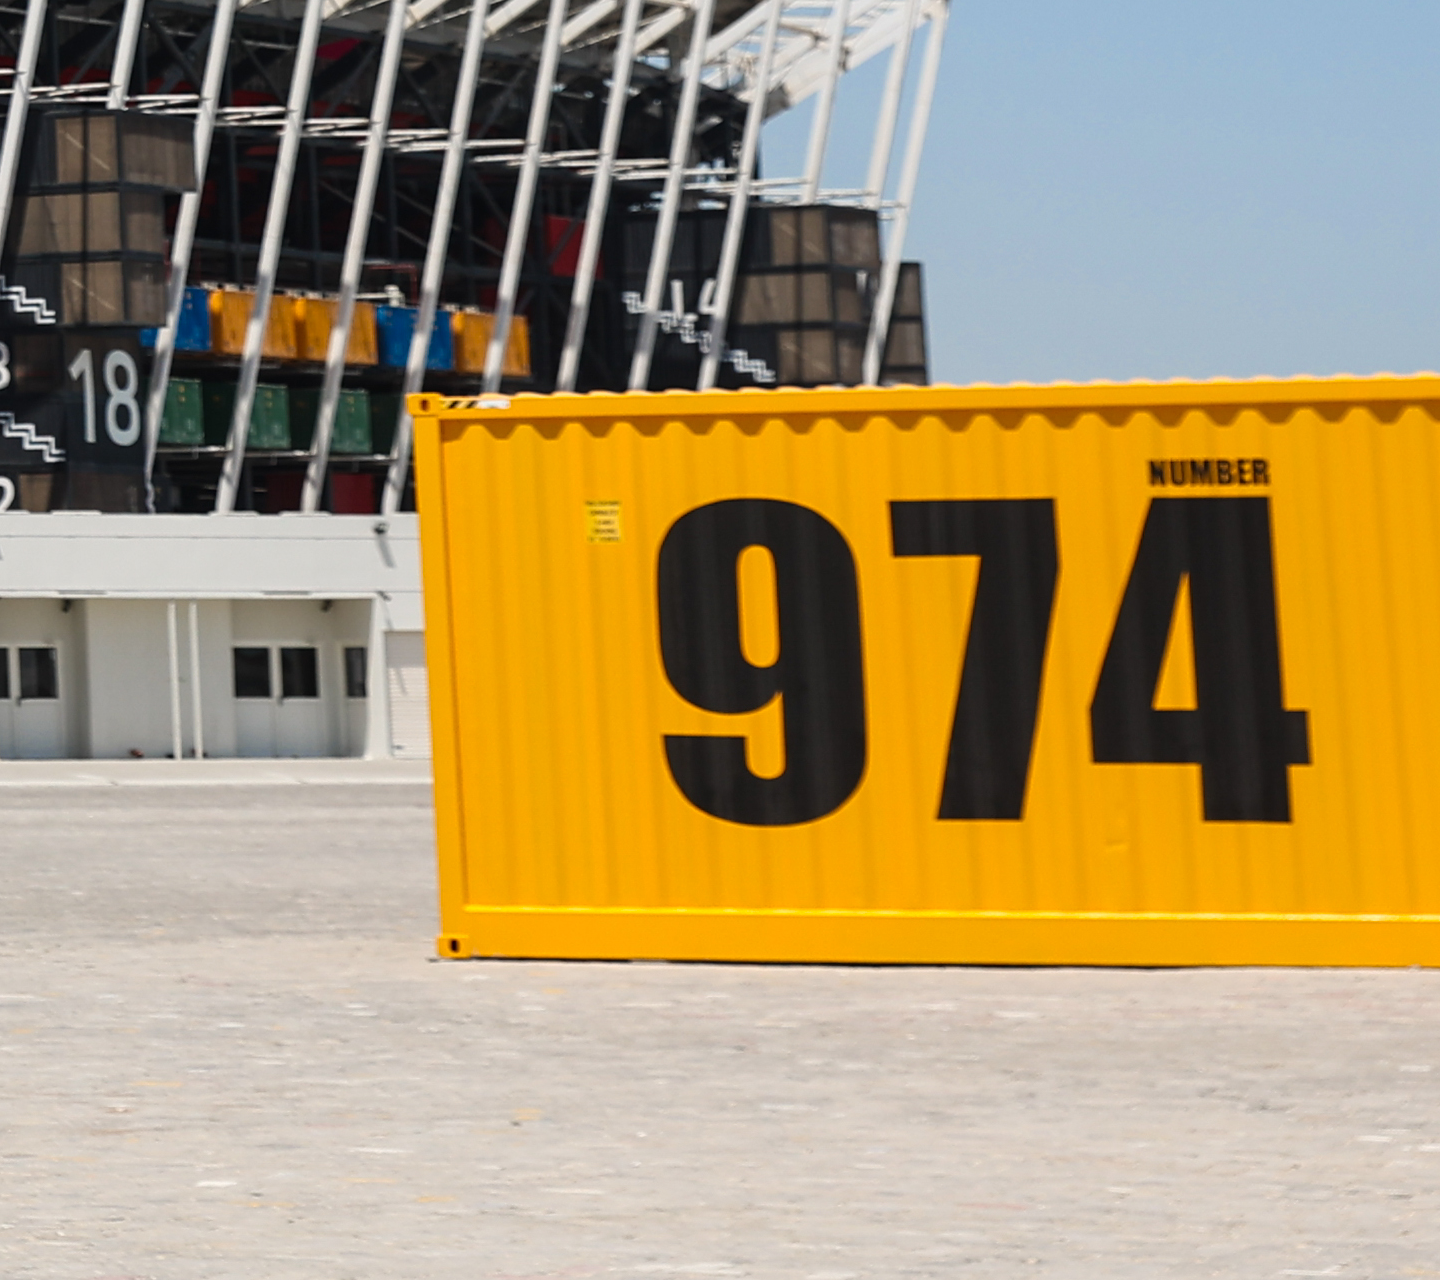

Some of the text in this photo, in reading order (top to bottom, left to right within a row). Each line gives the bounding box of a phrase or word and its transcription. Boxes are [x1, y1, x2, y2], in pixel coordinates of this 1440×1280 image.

[68, 348, 141, 447] 18
[1147, 458, 1270, 487] NUMBER
[656, 495, 1314, 828] 974
